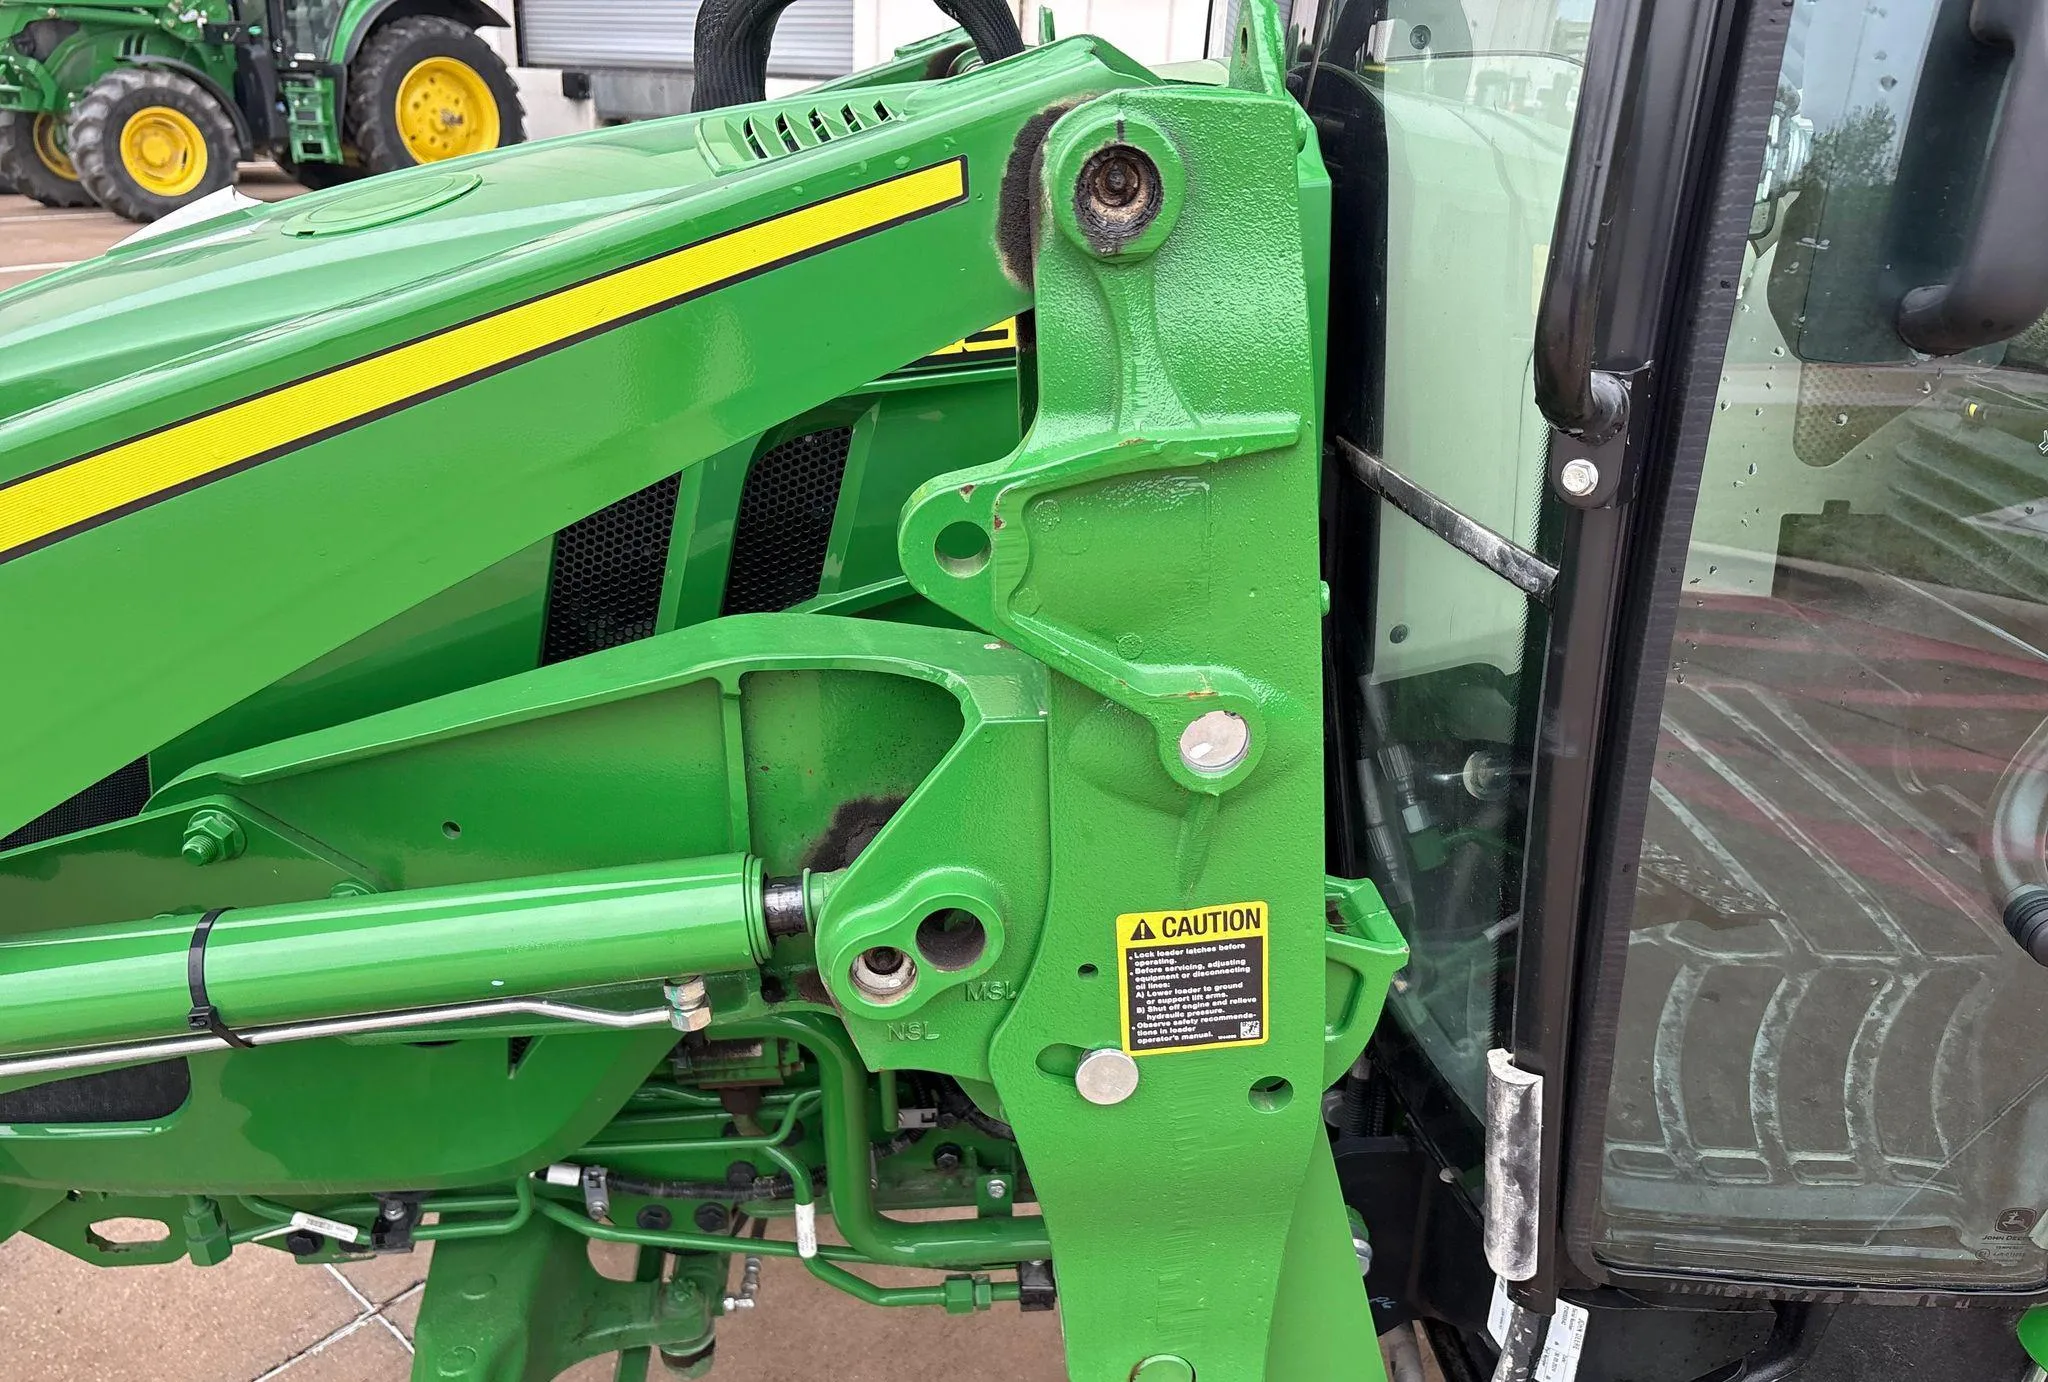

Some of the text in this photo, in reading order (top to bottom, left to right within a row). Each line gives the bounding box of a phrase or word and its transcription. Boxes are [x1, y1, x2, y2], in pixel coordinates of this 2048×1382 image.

[1162, 908, 1260, 938] CAUTION
[1134, 951, 1155, 959] Lock
[1186, 946, 1216, 954] latches
[1135, 967, 1162, 975] Before
[1208, 958, 1246, 969] adjusting
[1135, 973, 1179, 982] equipment
[1192, 966, 1251, 978] disconnecting
[965, 981, 1016, 1001] MSL
[1147, 989, 1172, 997] Lower
[1214, 982, 1243, 992] ground
[1147, 1005, 1166, 1013] Shut
[1169, 1003, 1180, 1011] off
[1182, 1002, 1209, 1011] engine
[1158, 996, 1190, 1004] support
[1147, 1011, 1184, 1021] hydraulic
[887, 1021, 940, 1042] NSL
[1137, 1021, 1170, 1029] Observe
[1173, 1019, 1199, 1027] safety
